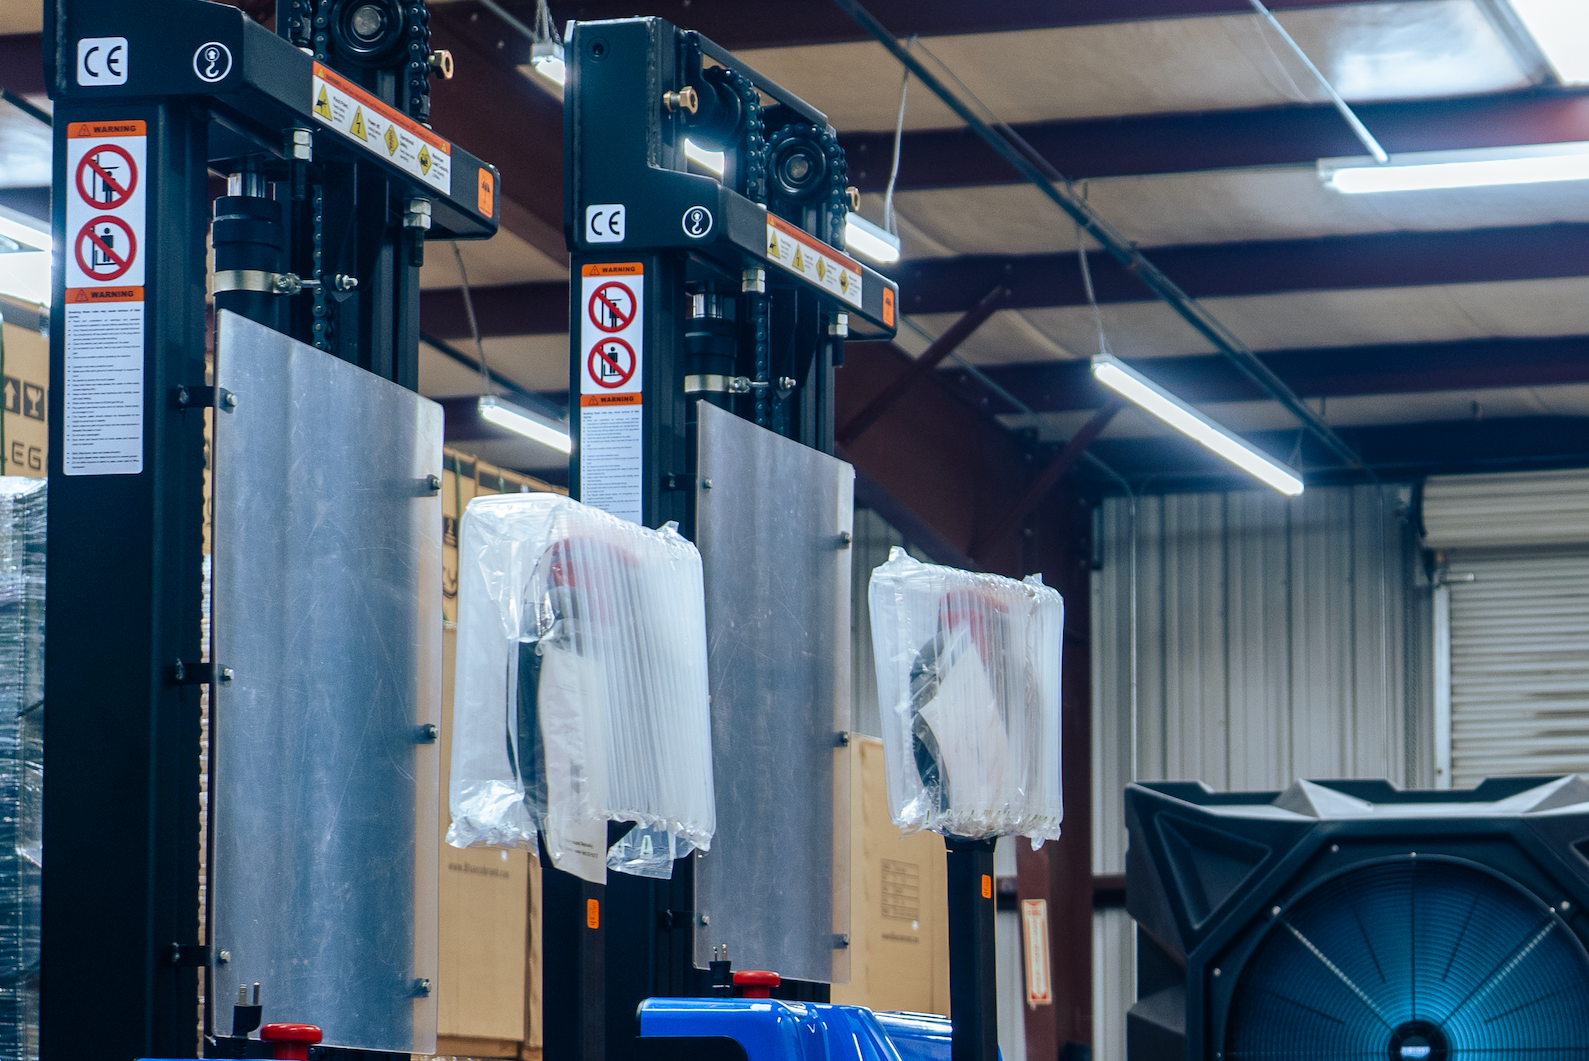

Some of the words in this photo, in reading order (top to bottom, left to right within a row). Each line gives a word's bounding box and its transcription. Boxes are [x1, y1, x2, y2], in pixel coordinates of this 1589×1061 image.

[84, 45, 122, 78] CE
[93, 125, 137, 133] WARNING
[591, 210, 621, 236] CE
[91, 290, 134, 299] WARNING
[600, 395, 634, 403] WARNING
